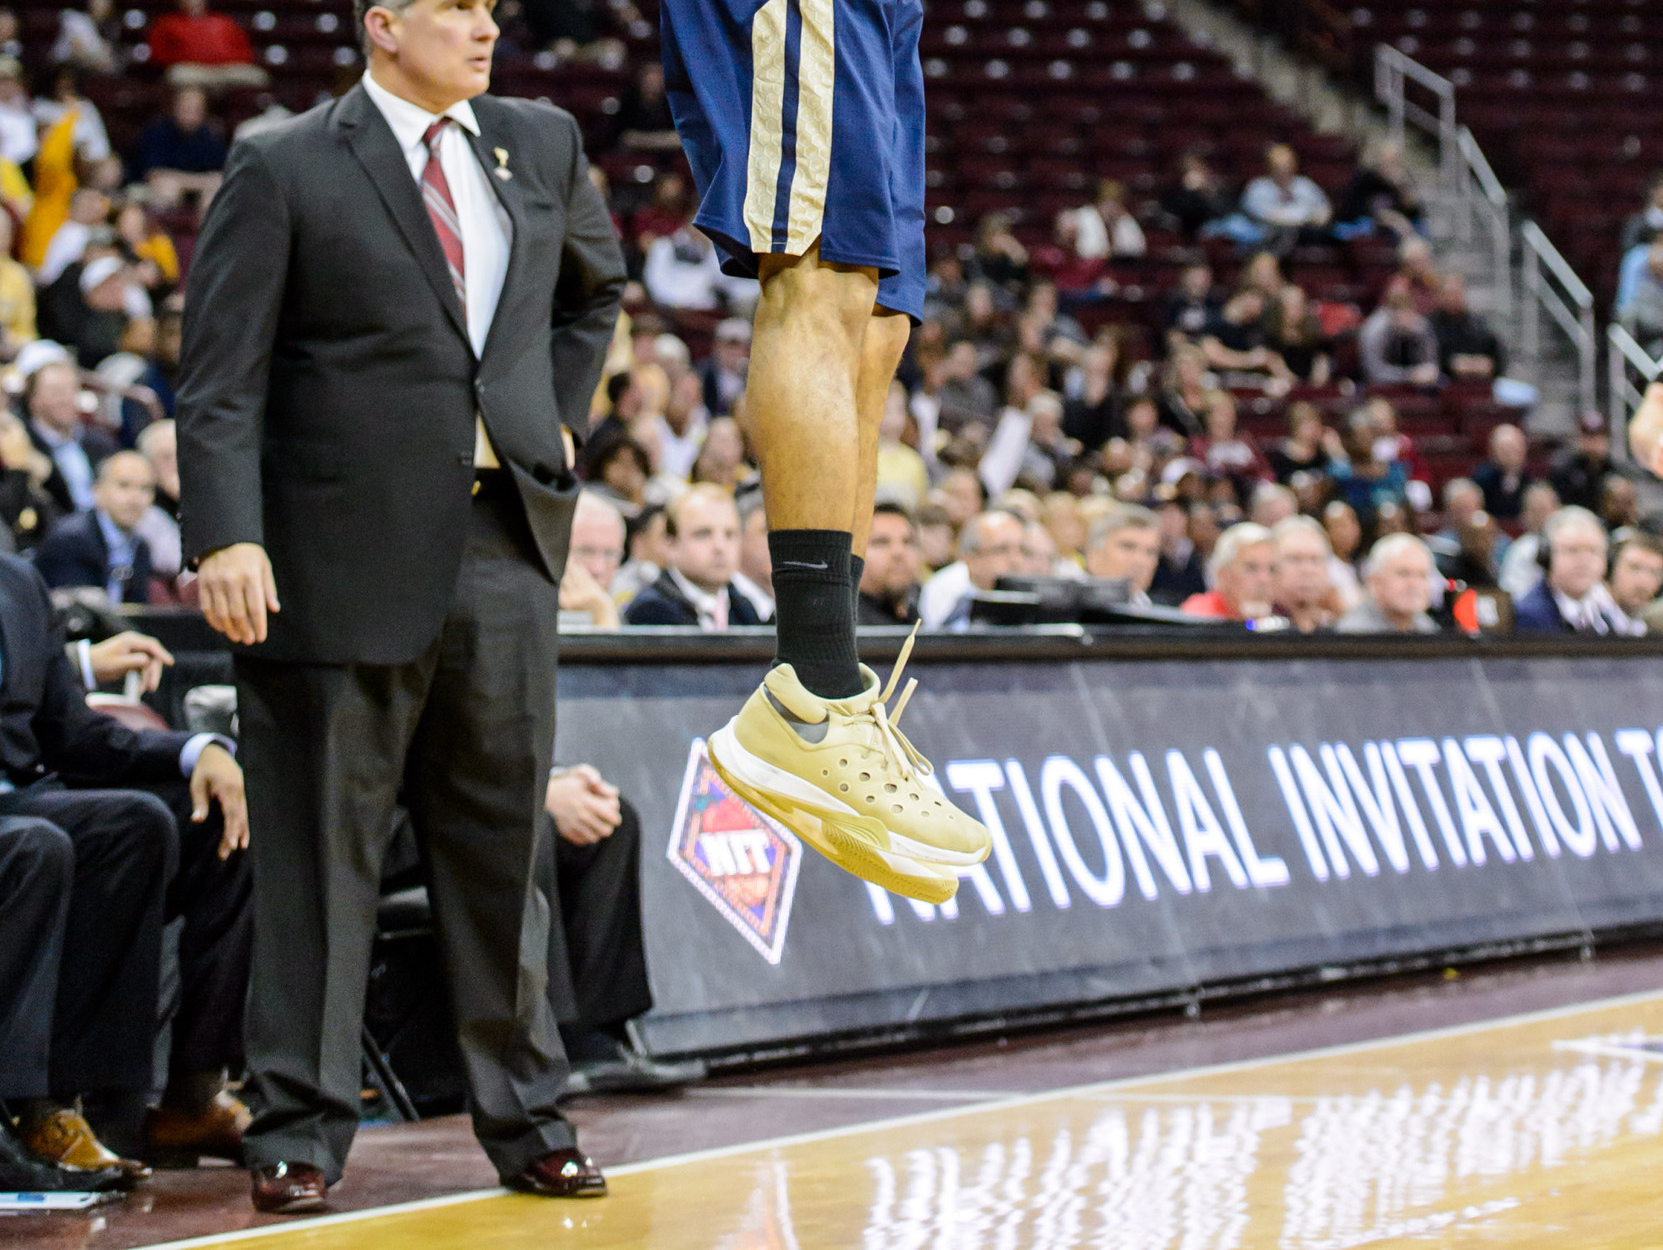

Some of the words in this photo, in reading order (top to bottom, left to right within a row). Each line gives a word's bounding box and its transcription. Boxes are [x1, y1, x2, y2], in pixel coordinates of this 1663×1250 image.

[699, 829, 770, 876] NIT
[865, 745, 1292, 927] ATIONAL
[1267, 731, 1643, 883] INVITATION
[1613, 726, 1663, 830] T
